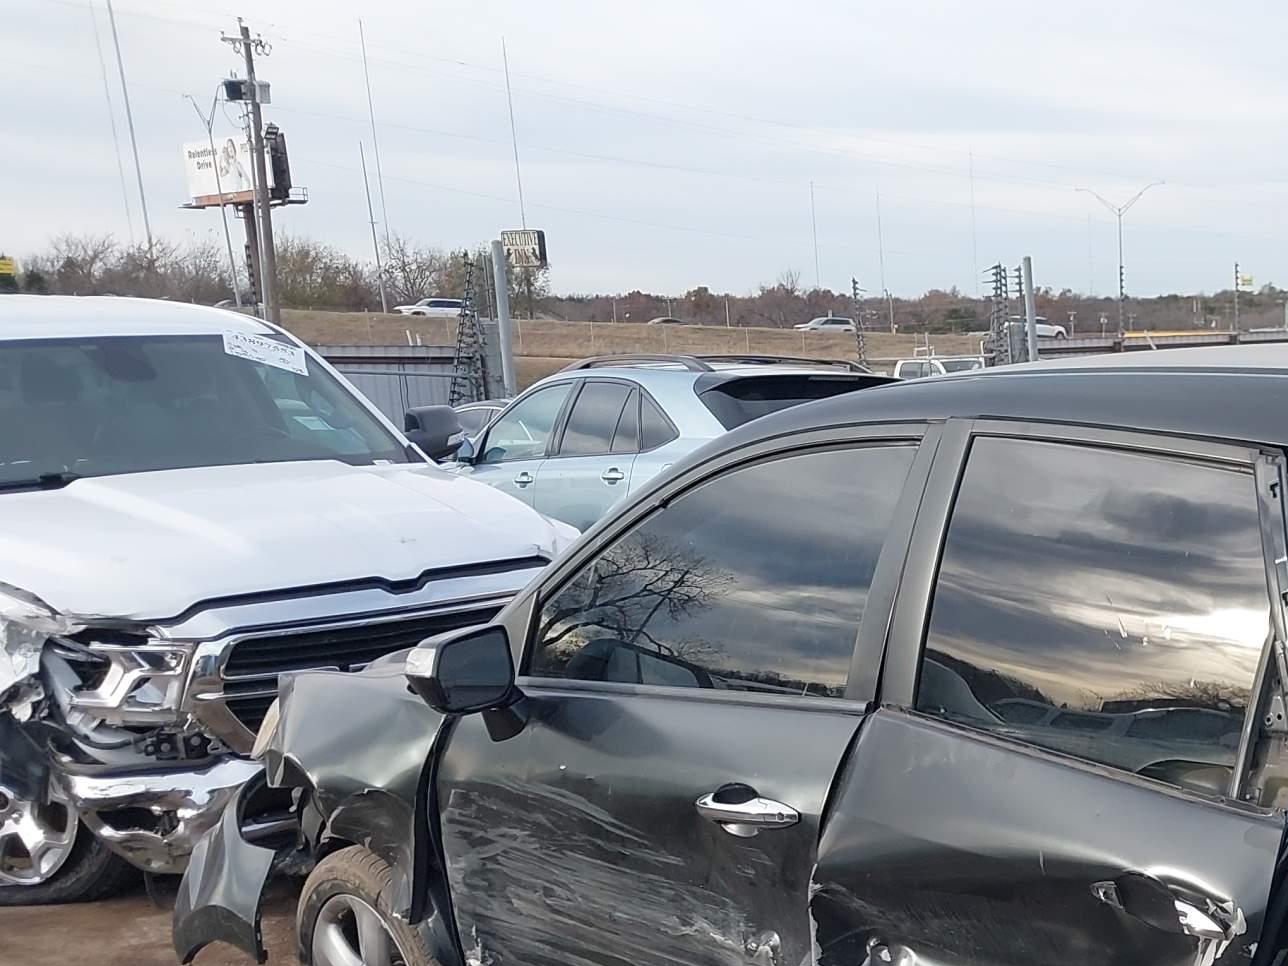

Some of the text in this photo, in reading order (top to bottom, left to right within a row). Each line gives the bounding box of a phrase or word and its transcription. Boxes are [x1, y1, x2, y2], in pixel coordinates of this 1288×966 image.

[187, 147, 218, 160] Relentles
[196, 159, 212, 170] Drive
[502, 232, 537, 247] EXECUTIVE
[514, 248, 530, 265] INN
